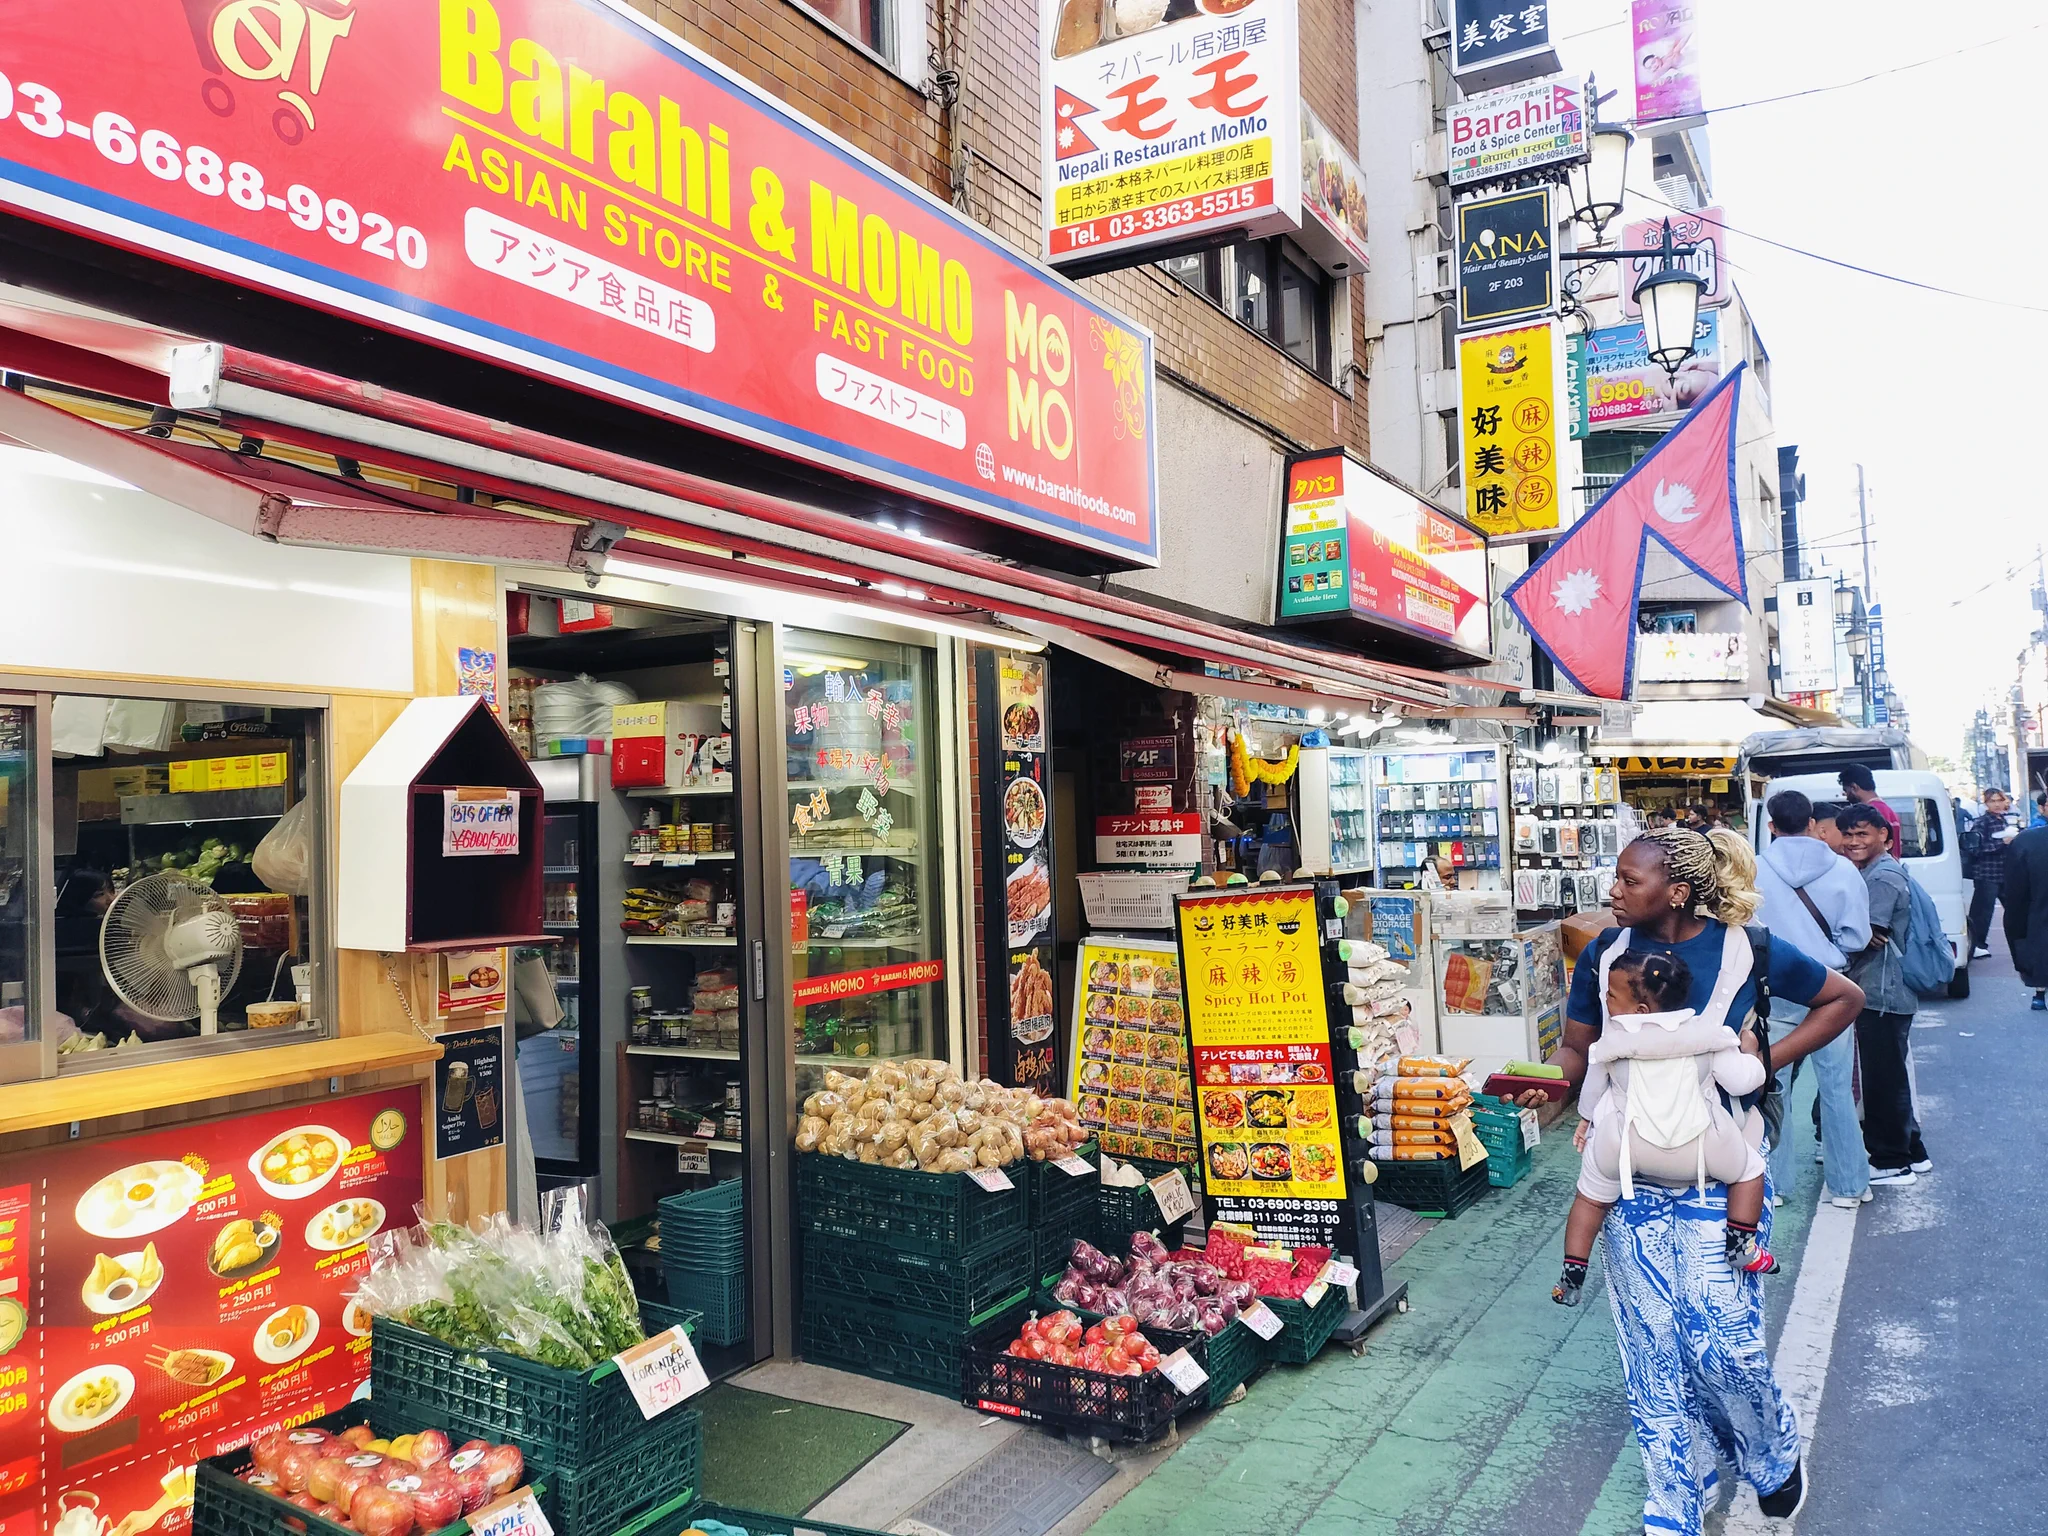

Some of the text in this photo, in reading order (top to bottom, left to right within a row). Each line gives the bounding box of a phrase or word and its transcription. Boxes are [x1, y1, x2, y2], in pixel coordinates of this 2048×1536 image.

[1459, 4, 1546, 53] 美容室
[1098, 18, 1268, 85] ネパール居酒屋
[1101, 50, 1269, 141] モモ
[1453, 86, 1551, 117] ネパールと南アジアの食材店
[1453, 95, 1551, 144] Barahi
[1562, 111, 1581, 134] 2F
[1058, 115, 1268, 182] Nepali Restaurant MoMo
[1451, 122, 1561, 159] Food & Spice Center
[1483, 140, 1554, 164] नेपाली पसल
[440, 0, 730, 230] Barahi
[747, 166, 795, 263] &
[810, 178, 973, 347] MOMO
[1070, 143, 1255, 202] 日本初・本格ネパール料理の店
[1466, 160, 1511, 180] 03-5386-8797
[1531, 143, 1584, 164] 090-6094-9954
[1058, 161, 1270, 225] 甘口から激辛までのスパイス料理店
[1067, 186, 1256, 248] Tel. 03-3363-5515
[442, 140, 974, 397] ASIAN STORE & FAST FOOD
[1462, 251, 1550, 275] Hair and Beauty Salon
[488, 228, 694, 341] アジア食品店
[1488, 277, 1524, 292] 2F 203
[1004, 290, 1071, 388] MO
[830, 363, 952, 437] ファストフード
[1007, 376, 1075, 461] MO
[1471, 405, 1508, 516] 好美味
[1520, 403, 1545, 505] 麻辣湯
[1001, 462, 1137, 527] www.barahifoods.com
[1293, 475, 1336, 499] タバコ
[1293, 499, 1336, 513] TOBACCO
[1308, 510, 1319, 521] &
[1292, 592, 1339, 605] Available Here
[1801, 593, 1810, 605] B
[1803, 610, 1812, 662] CHARM
[824, 671, 864, 704] 輸入
[1808, 678, 1820, 687] 2F
[793, 702, 830, 736] 果物
[1138, 750, 1159, 765] 4F
[450, 803, 514, 823] BIG OFFER
[792, 786, 832, 836] 食材
[856, 787, 894, 843] 野菜
[1111, 819, 1184, 833] テナント募集中
[826, 855, 865, 887] 青果
[1221, 913, 1270, 931] 好美味
[1222, 929, 1269, 939] マーラータン
[1372, 920, 1411, 928] STORAGE
[1200, 940, 1301, 957] マーラータン
[880, 963, 939, 982] BARAHI & MOMO
[1208, 961, 1297, 987] 麻辣湯
[798, 976, 865, 997] BARAHI & MOMO
[1204, 991, 1309, 1008] Spicy Hot Pot
[474, 1055, 497, 1066] Highball
[1200, 1049, 1284, 1061] テレビでも紹介され
[441, 1120, 466, 1131] Super Dry
[680, 1153, 708, 1164] GARLIC
[342, 1165, 361, 1179] 500
[1161, 1187, 1183, 1206] GARLIC
[1248, 1198, 1338, 1212] 03-6908-8396
[232, 1292, 253, 1308] 250
[105, 1329, 128, 1348] 500
[270, 1377, 290, 1396] 500
[177, 1411, 198, 1429] 500
[215, 1434, 250, 1456] Nepali
[250, 1421, 282, 1442] CHIYA
[162, 1511, 182, 1531] Tea
